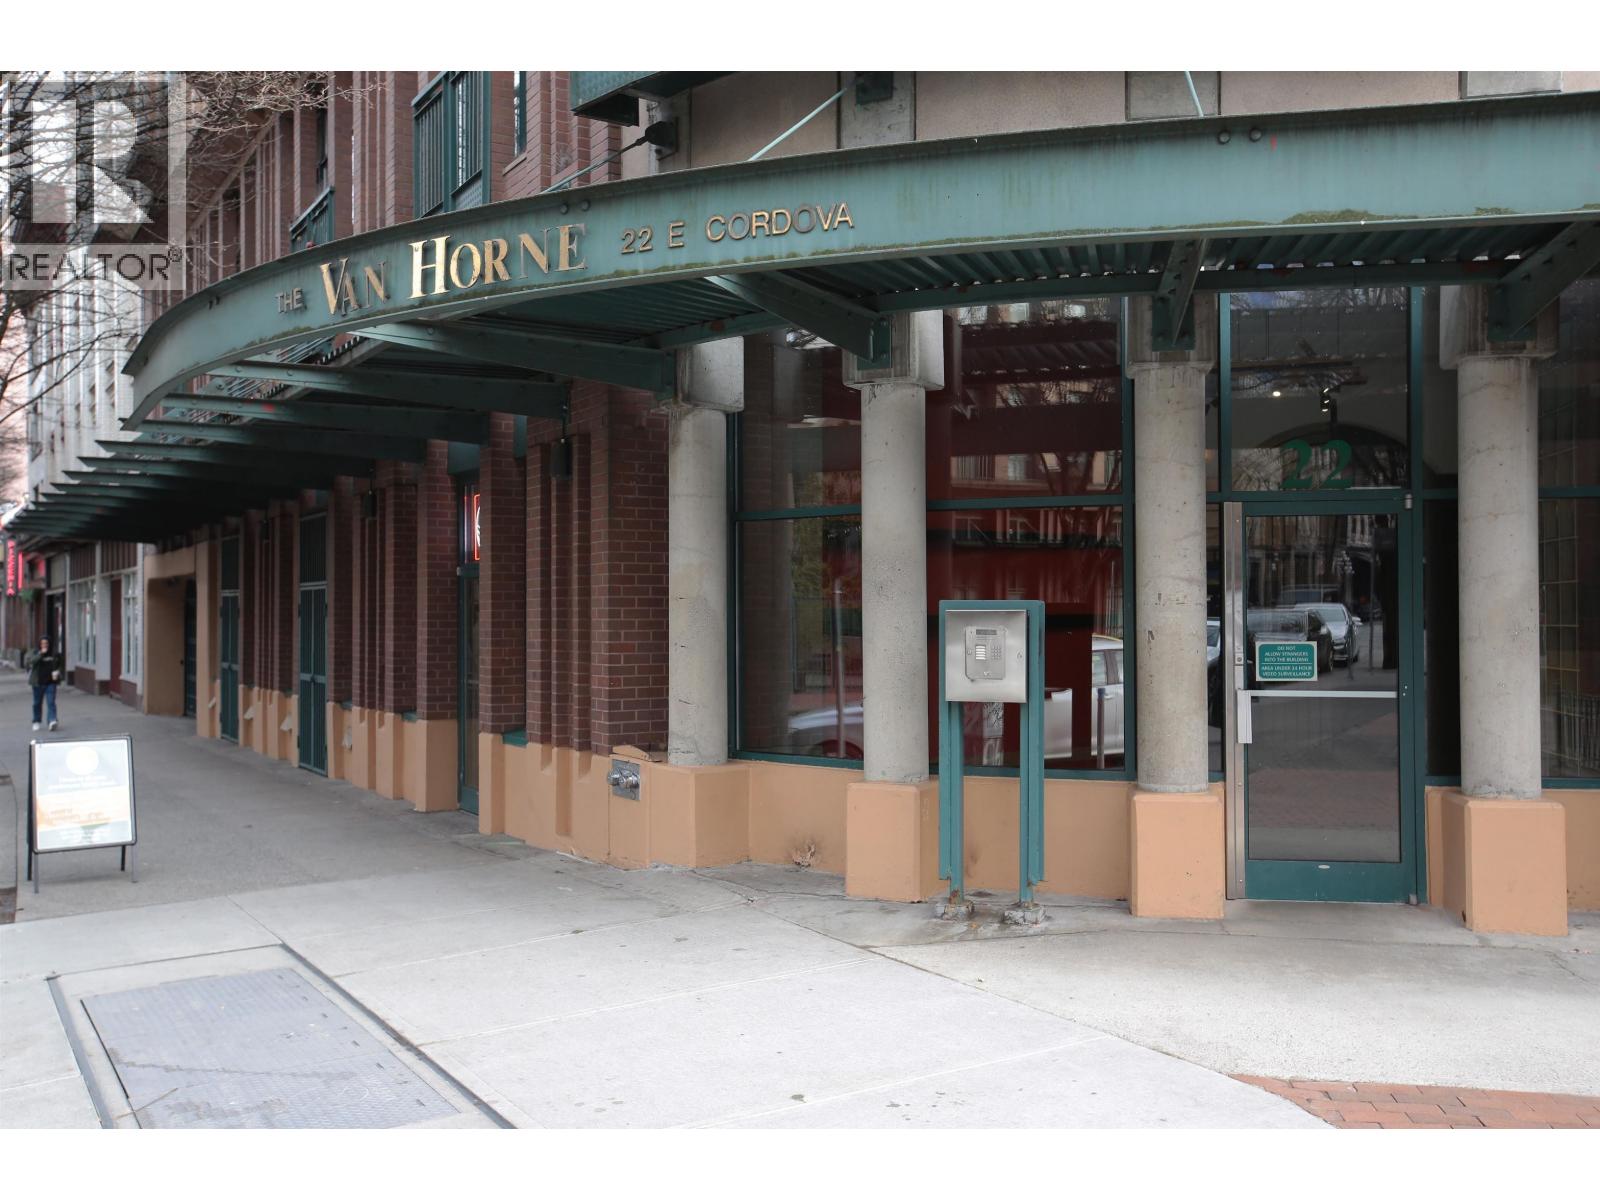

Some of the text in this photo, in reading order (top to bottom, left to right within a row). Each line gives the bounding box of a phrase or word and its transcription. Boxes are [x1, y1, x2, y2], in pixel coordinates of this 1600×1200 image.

[620, 202, 855, 255] 22 E CORDOVA
[274, 287, 306, 315] THE
[1281, 438, 1354, 490] 22
